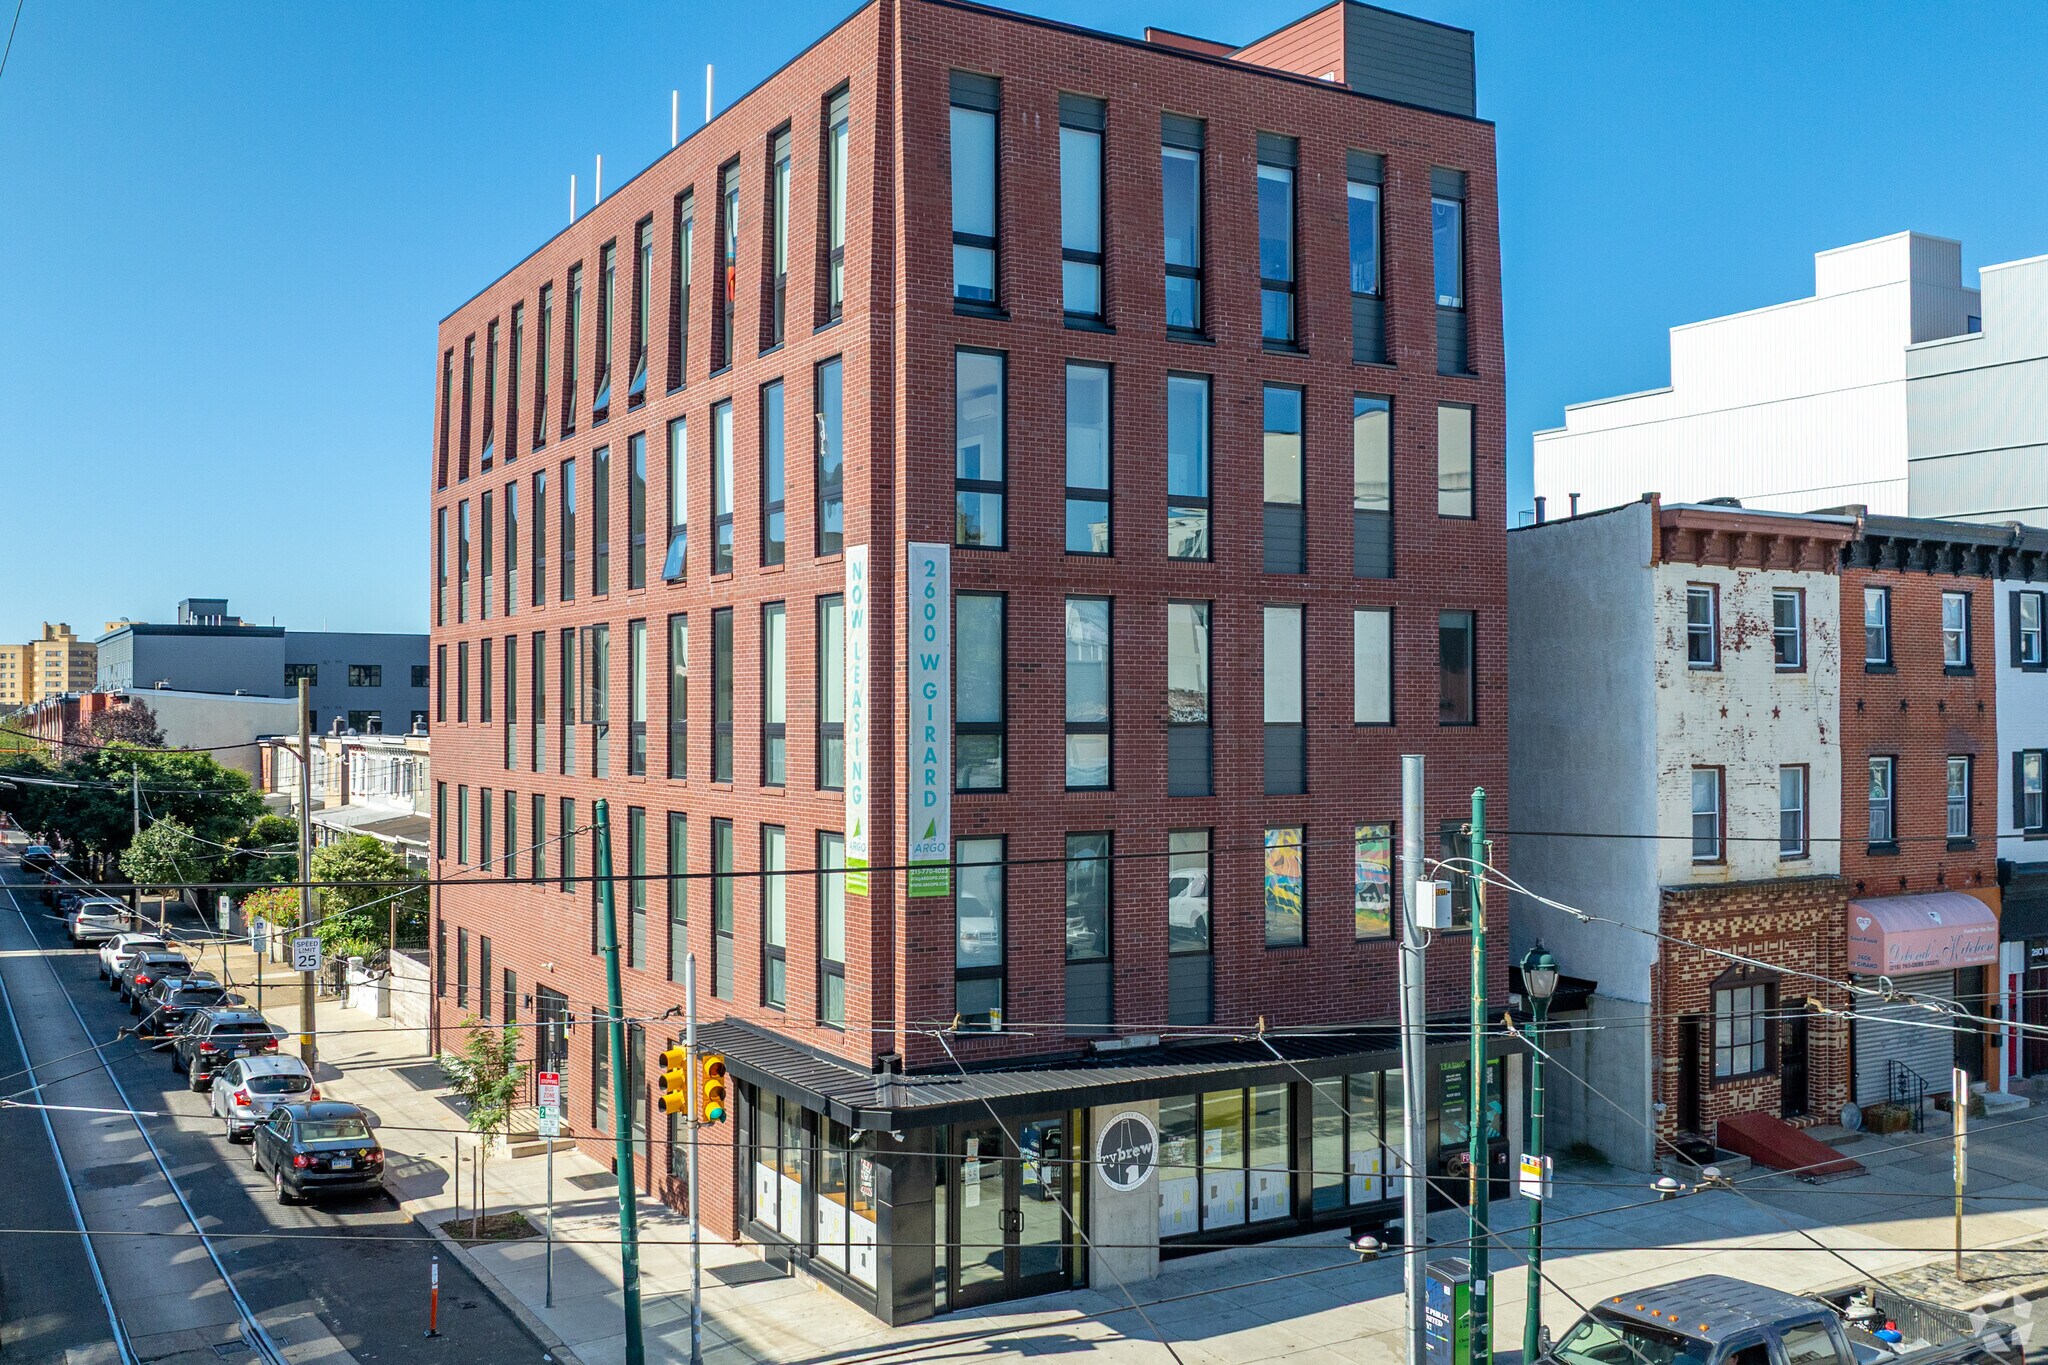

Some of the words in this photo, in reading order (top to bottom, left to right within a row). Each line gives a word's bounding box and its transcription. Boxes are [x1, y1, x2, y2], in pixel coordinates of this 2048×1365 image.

[851, 561, 863, 629] NOW
[924, 560, 936, 642] 2600
[920, 653, 941, 671] W
[852, 642, 862, 805] LEASING
[922, 682, 938, 808] GIRARD
[914, 843, 946, 854] ARGO
[1942, 934, 1995, 961] Kitchen
[298, 955, 317, 967] 25
[1440, 1061, 1466, 1070] LEASING
[1100, 1143, 1153, 1169] rybrew
[1426, 1314, 1443, 1328] NITED
